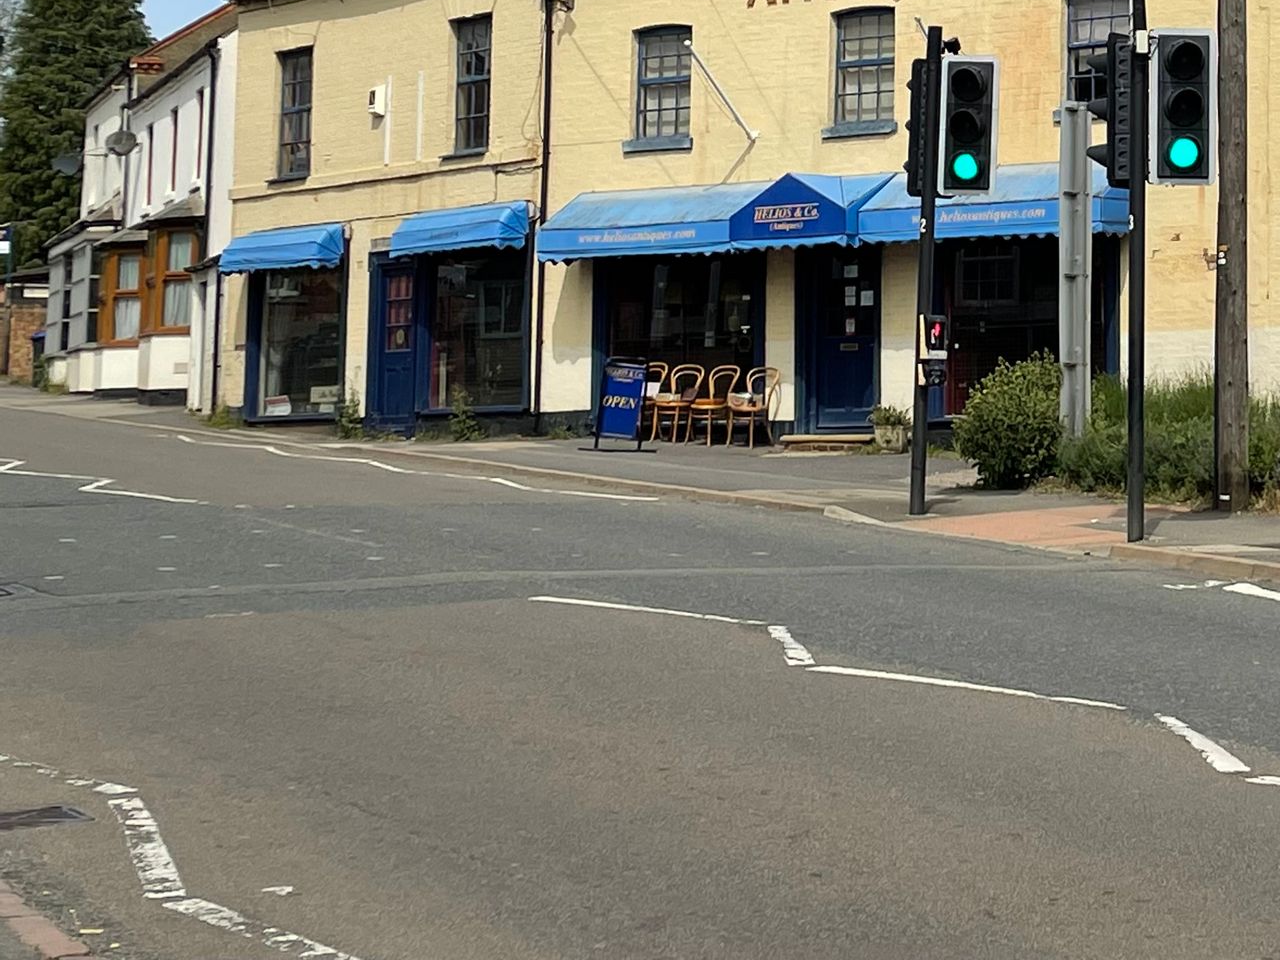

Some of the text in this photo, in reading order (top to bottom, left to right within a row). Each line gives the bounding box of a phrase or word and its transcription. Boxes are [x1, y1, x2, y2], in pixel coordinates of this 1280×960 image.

[754, 207, 792, 220] HELIOS
[794, 207, 802, 218] &
[920, 218, 926, 233] 2
[1129, 214, 1134, 230] 3
[603, 395, 638, 409] OPEN
